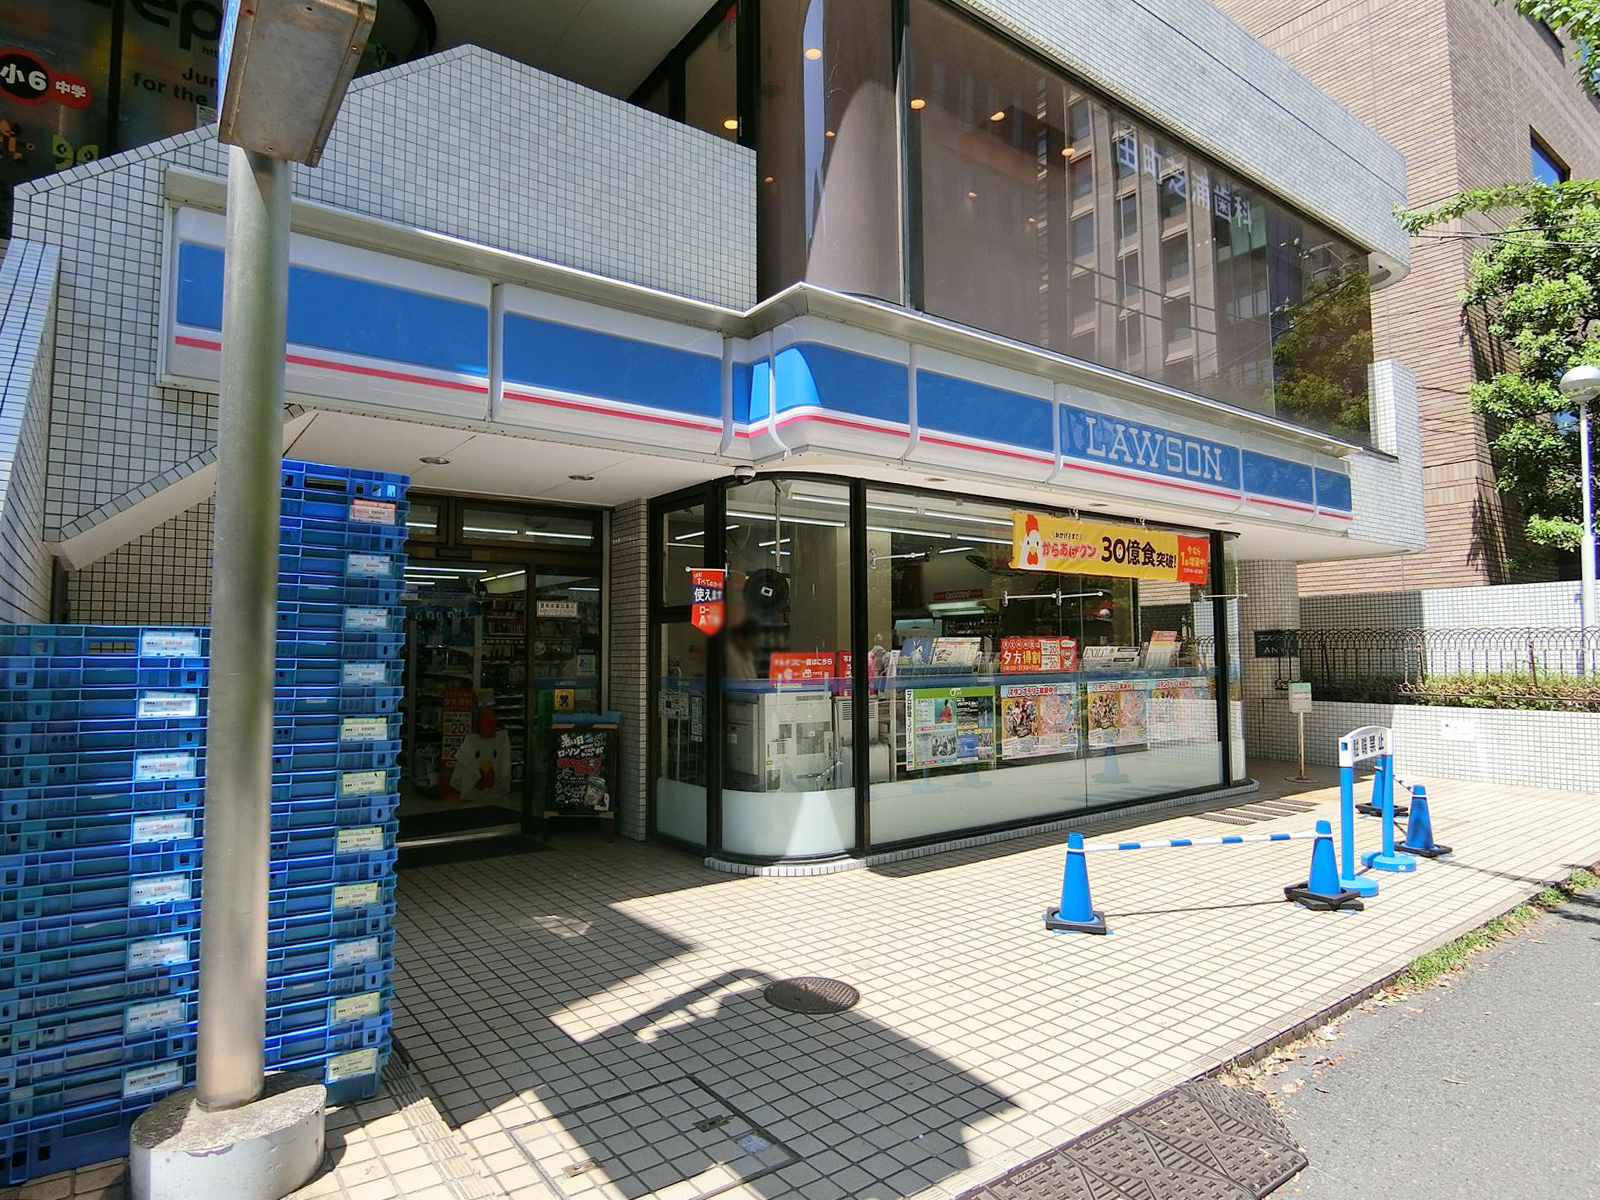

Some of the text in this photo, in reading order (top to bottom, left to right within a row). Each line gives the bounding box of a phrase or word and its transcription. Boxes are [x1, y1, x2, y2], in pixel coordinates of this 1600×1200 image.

[0, 62, 48, 92] 小6
[55, 80, 87, 99] 中学
[133, 72, 208, 107] for the
[1085, 417, 1223, 482] LAWSON
[1042, 540, 1097, 560] からあげクン
[1002, 650, 1041, 665] 夕方得割
[451, 723, 466, 734] 20
